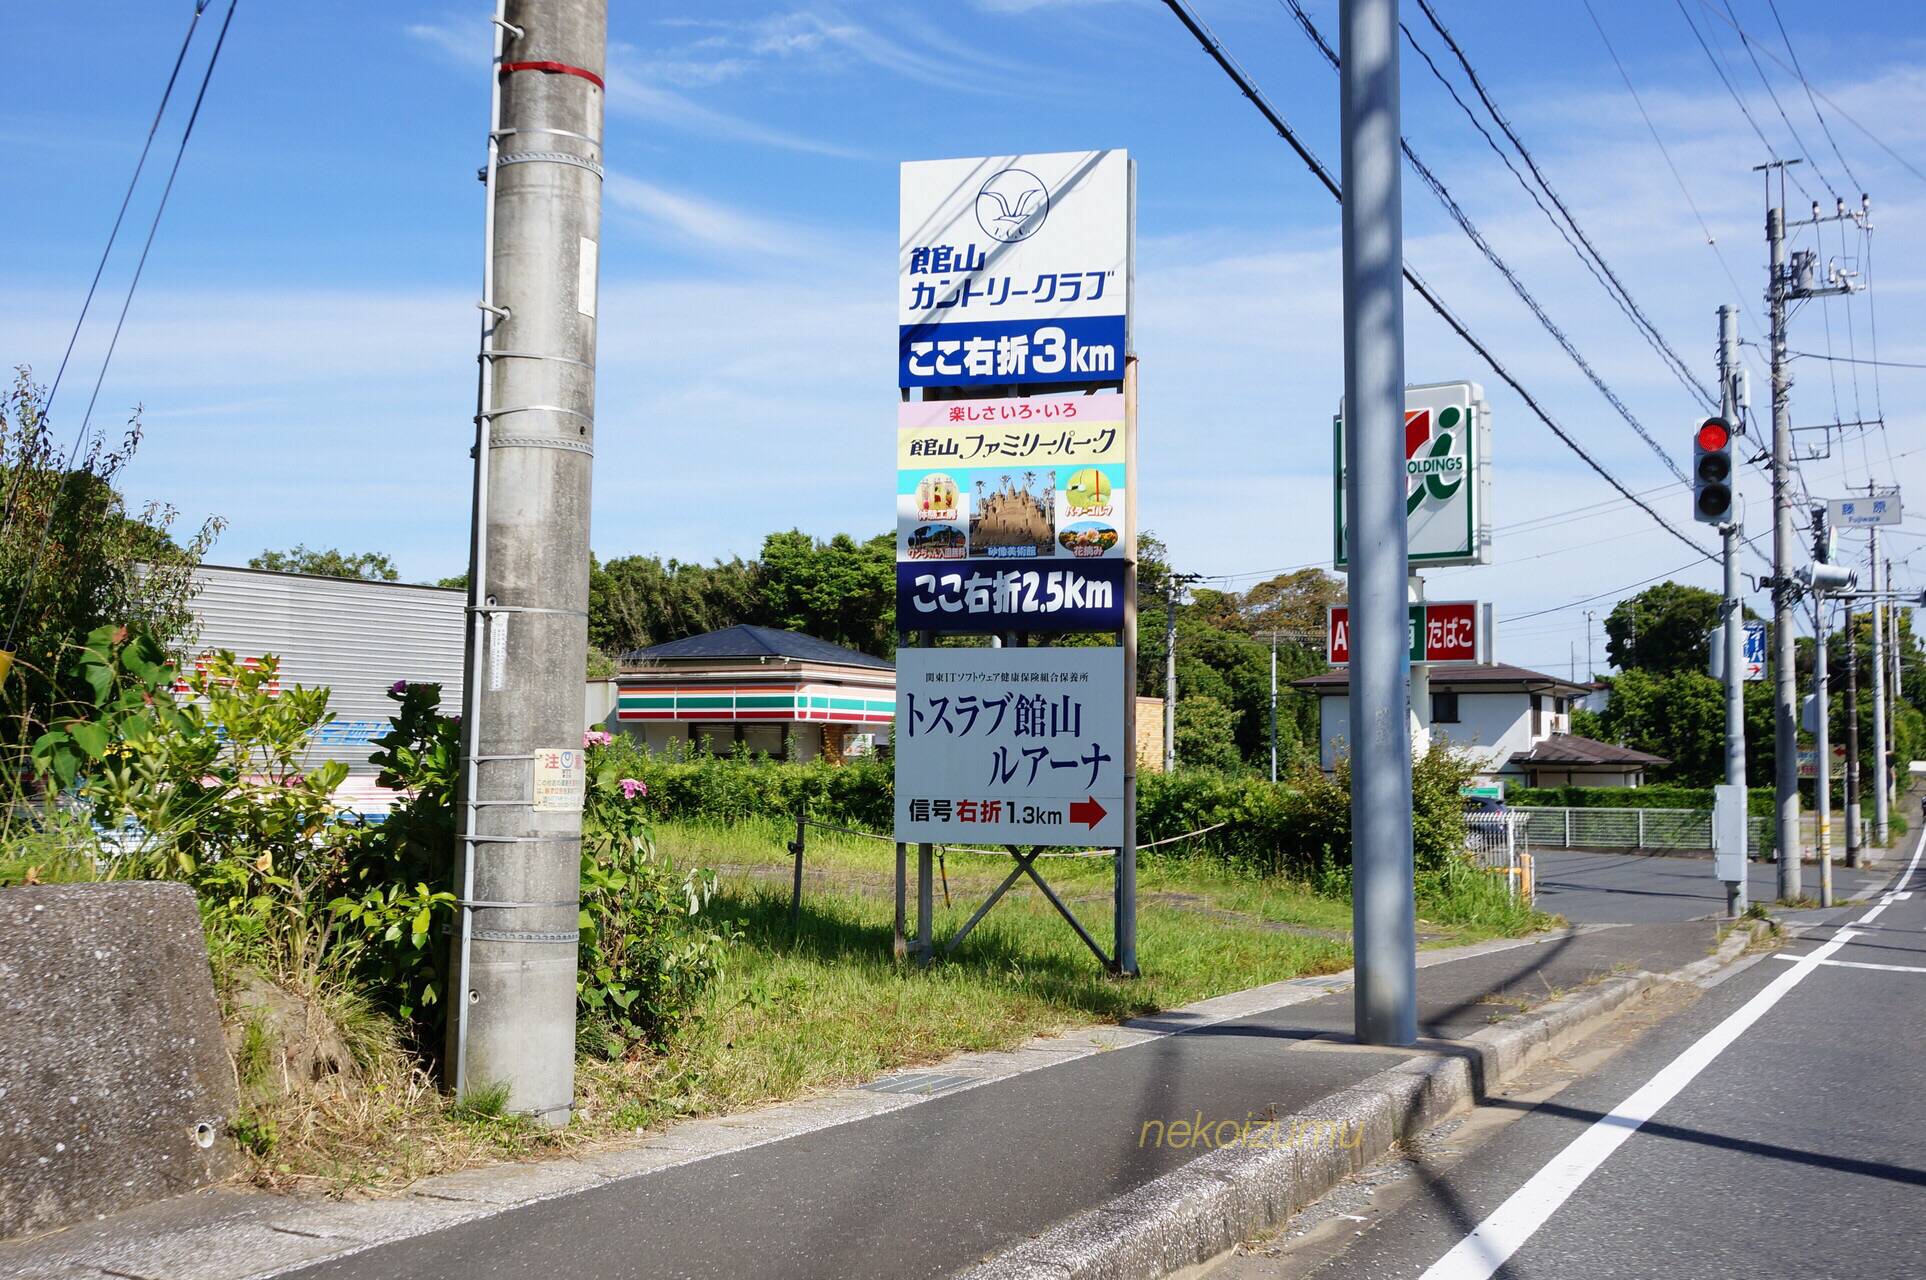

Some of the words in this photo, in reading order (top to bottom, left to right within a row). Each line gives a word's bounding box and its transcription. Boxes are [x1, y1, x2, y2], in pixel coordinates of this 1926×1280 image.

[909, 244, 986, 275] 館山
[908, 271, 1115, 310] カントリークラブ
[909, 428, 1116, 460] 館山ファミリーパーク
[1406, 457, 1463, 474] OLDINGS
[912, 570, 1113, 614] ここ右折2.5km
[1428, 617, 1473, 649] たばこ
[906, 691, 1082, 738] トスラブ館山
[987, 742, 1112, 791] ルアーナ
